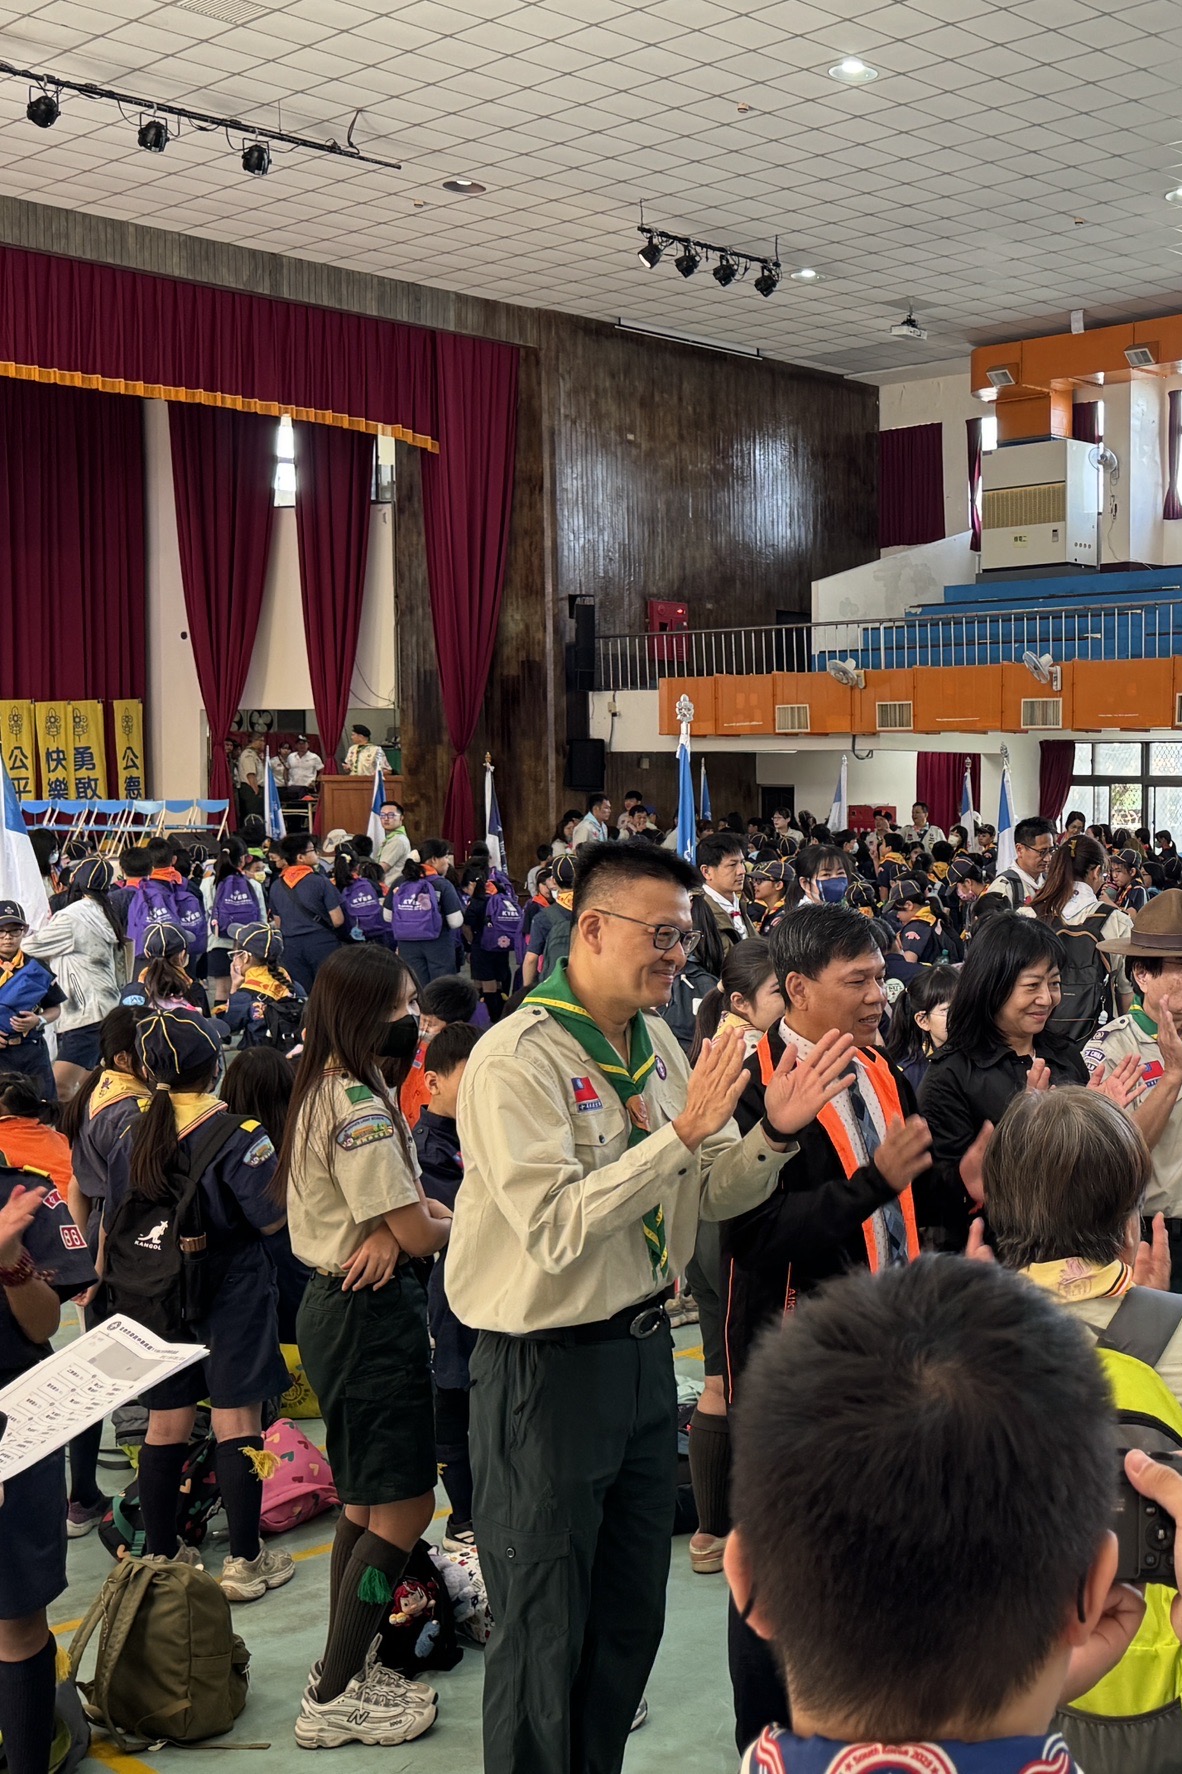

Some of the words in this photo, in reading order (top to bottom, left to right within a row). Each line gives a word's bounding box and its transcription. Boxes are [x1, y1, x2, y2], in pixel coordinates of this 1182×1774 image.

[9, 746, 32, 800] 公平
[45, 747, 69, 800] 快樂
[74, 746, 103, 800] 勇敢
[122, 746, 142, 800] 公德
[63, 1229, 81, 1247] 86
[134, 1240, 162, 1251] KANGOL
